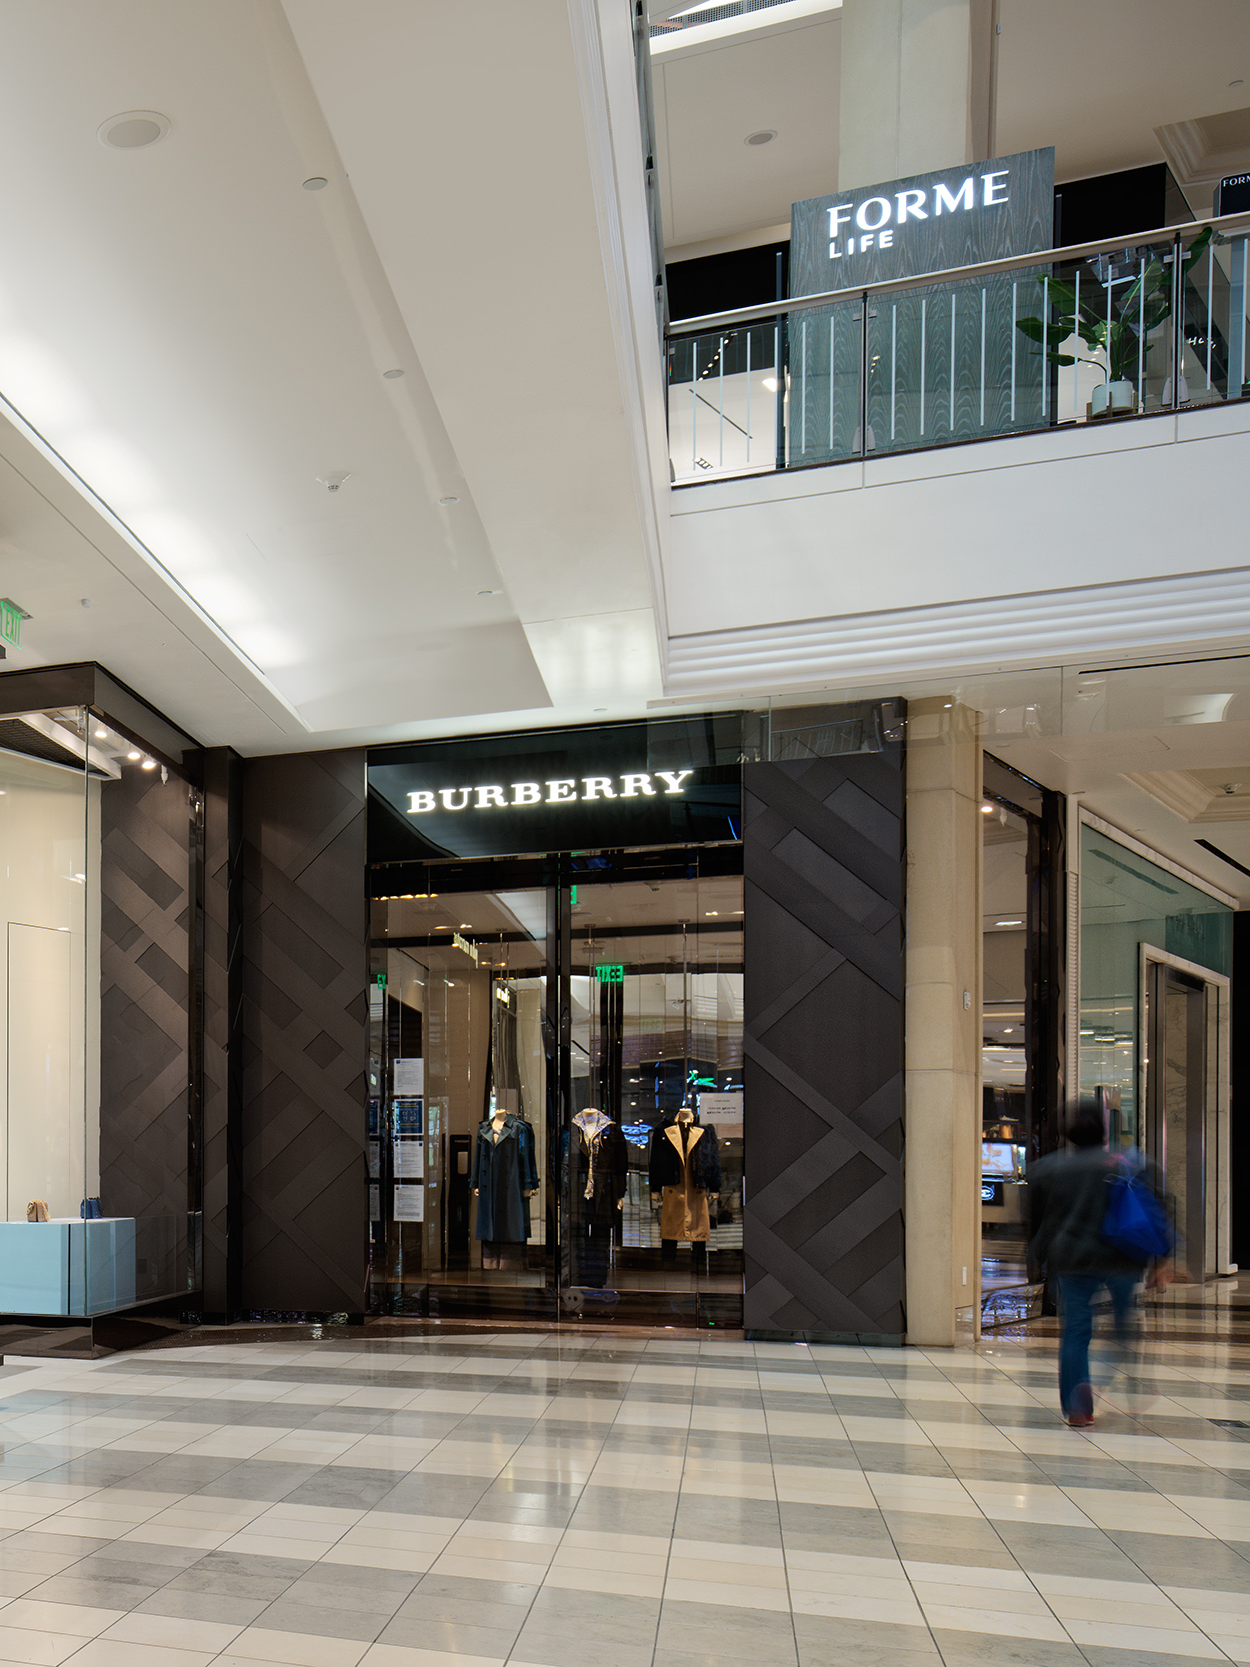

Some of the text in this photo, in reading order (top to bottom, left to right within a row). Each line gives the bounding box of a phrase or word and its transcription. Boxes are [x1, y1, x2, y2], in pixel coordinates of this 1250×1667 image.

[826, 169, 1010, 239] FORME
[829, 229, 894, 259] LIFE
[5, 607, 22, 645] EXIT
[406, 769, 694, 814] BURBERRY
